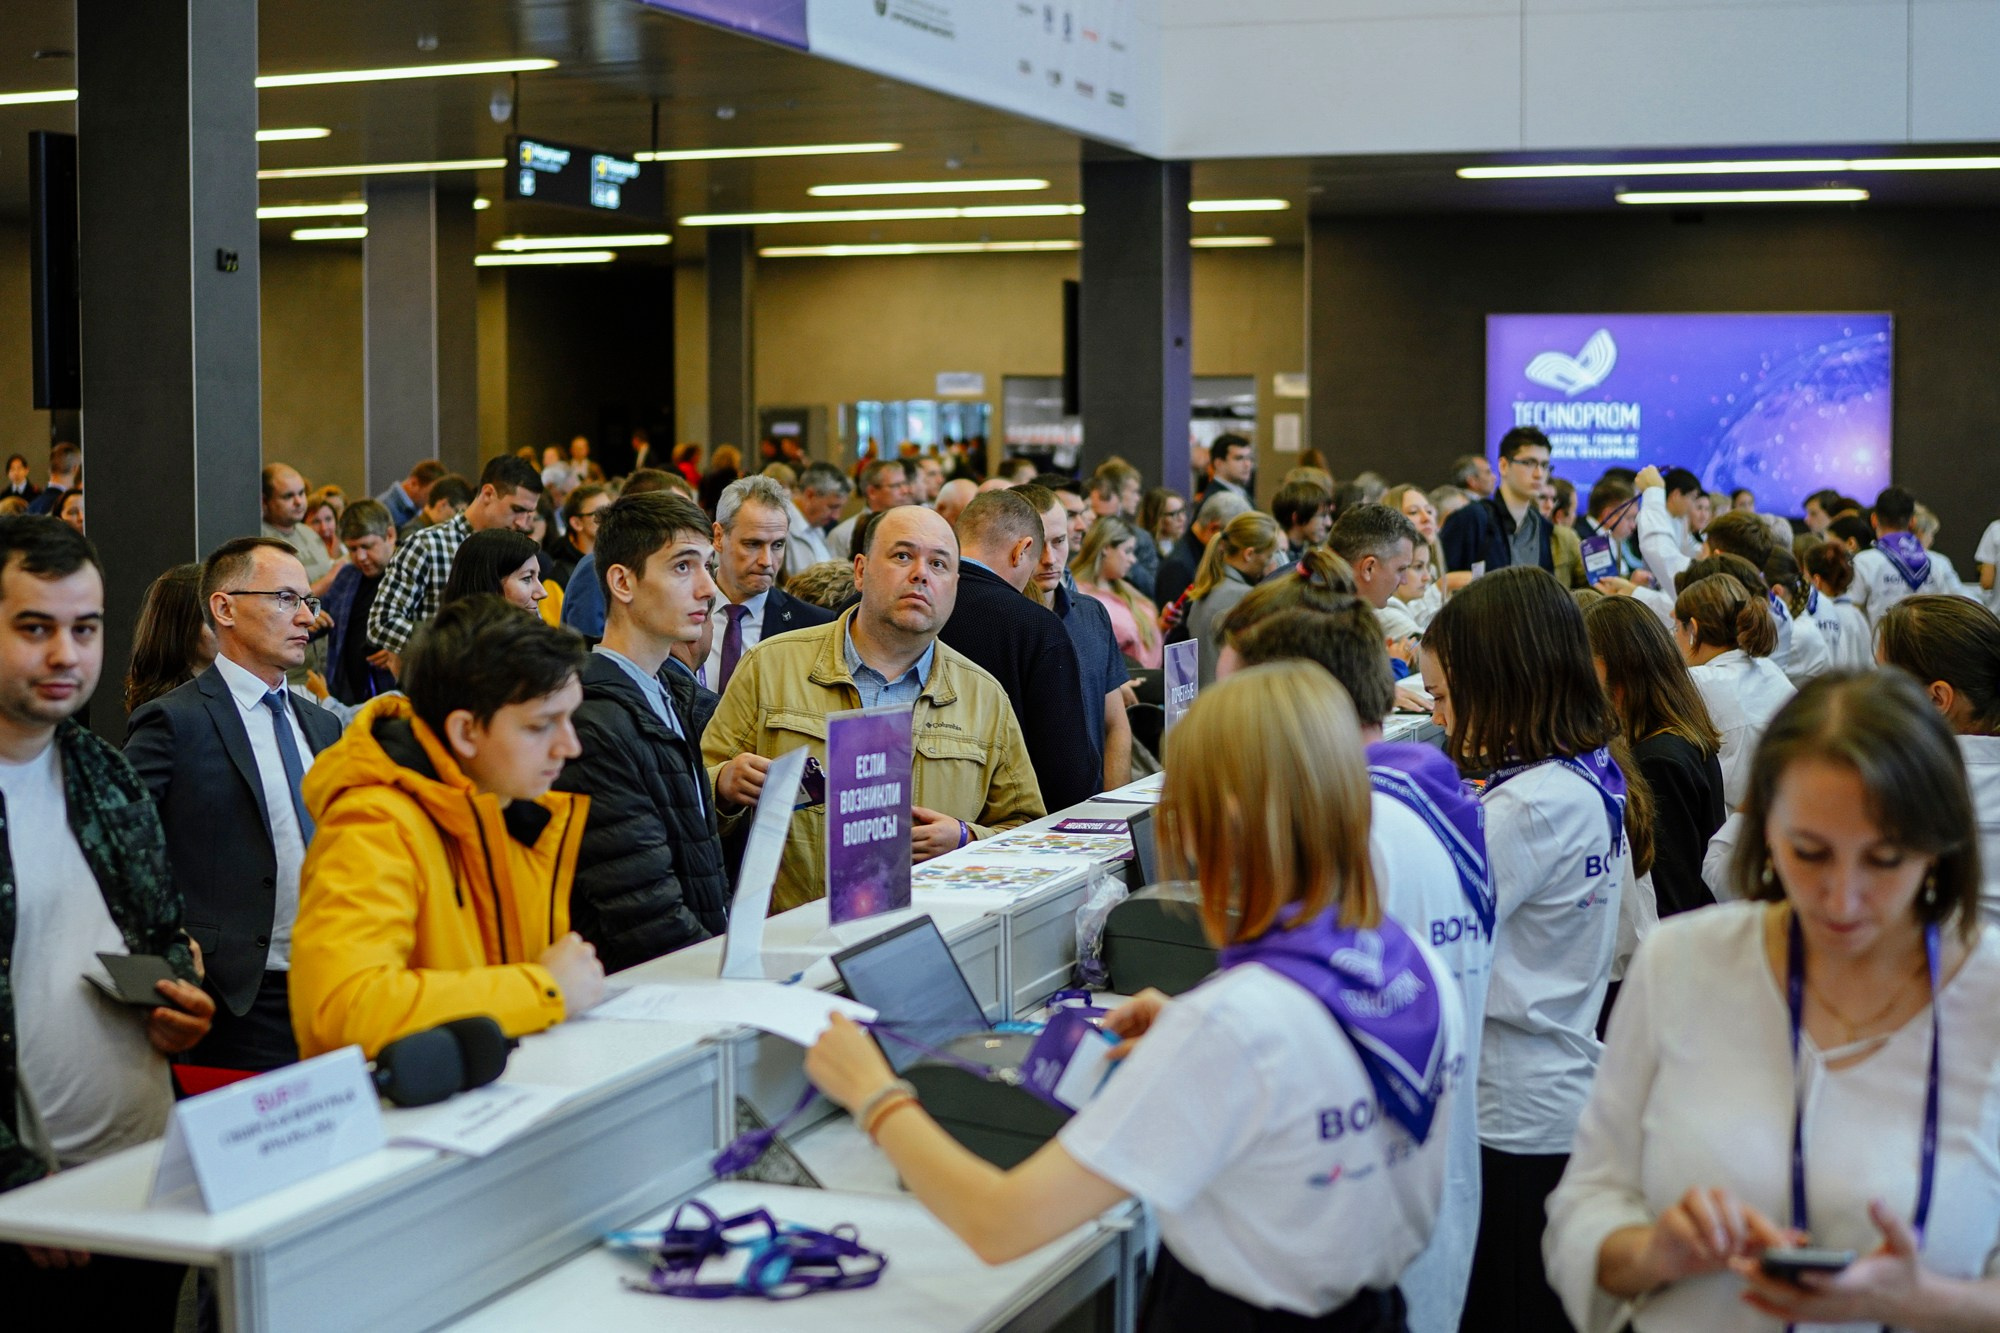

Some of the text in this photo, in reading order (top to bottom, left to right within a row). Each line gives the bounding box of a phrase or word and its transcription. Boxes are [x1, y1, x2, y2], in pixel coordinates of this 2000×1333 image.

[1512, 401, 1640, 430] TECHNOPROM
[932, 721, 962, 731] Columbia
[856, 752, 887, 779] ЕСЛИ
[840, 782, 901, 815] ВОЗНИКЛИ
[843, 814, 897, 847] ВОПРОСЫ
